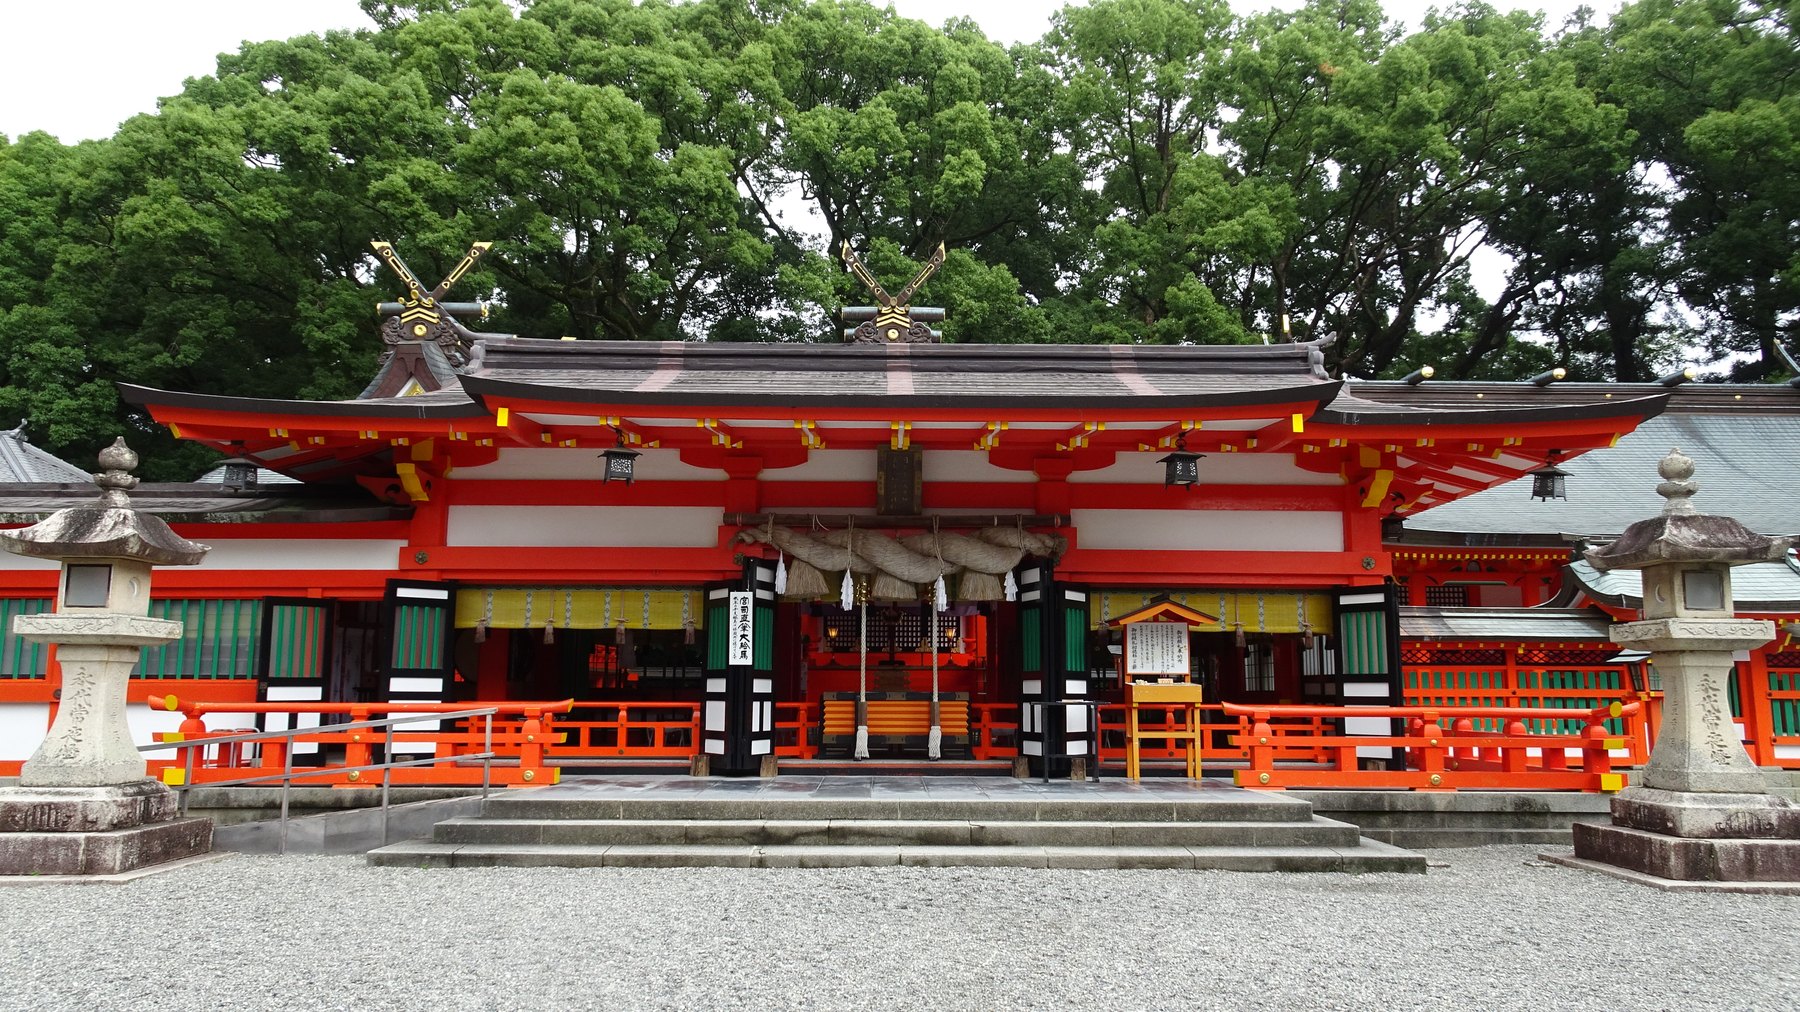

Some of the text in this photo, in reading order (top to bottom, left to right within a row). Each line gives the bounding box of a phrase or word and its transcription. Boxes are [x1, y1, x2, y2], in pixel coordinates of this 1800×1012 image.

[737, 596, 751, 660] 宮司直筆大絵馬
